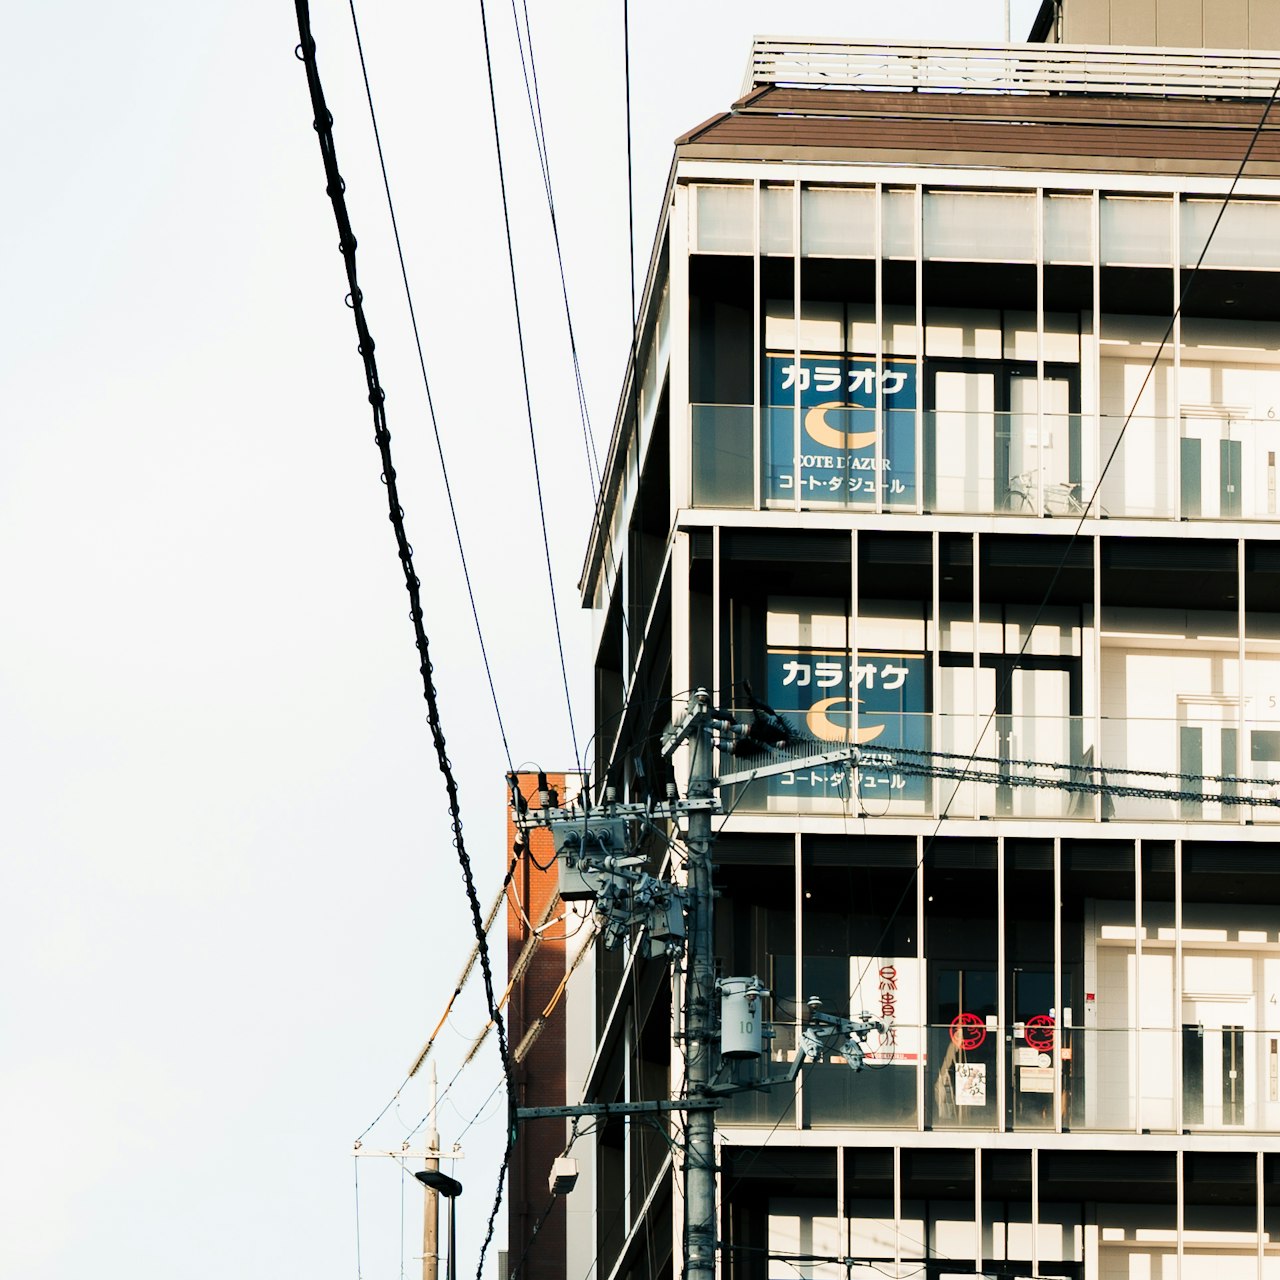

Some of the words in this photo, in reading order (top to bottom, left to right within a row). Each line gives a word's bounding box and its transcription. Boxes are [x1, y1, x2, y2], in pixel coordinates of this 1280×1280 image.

[781, 365, 908, 394] カラオケ
[782, 661, 909, 690] カラオケ
